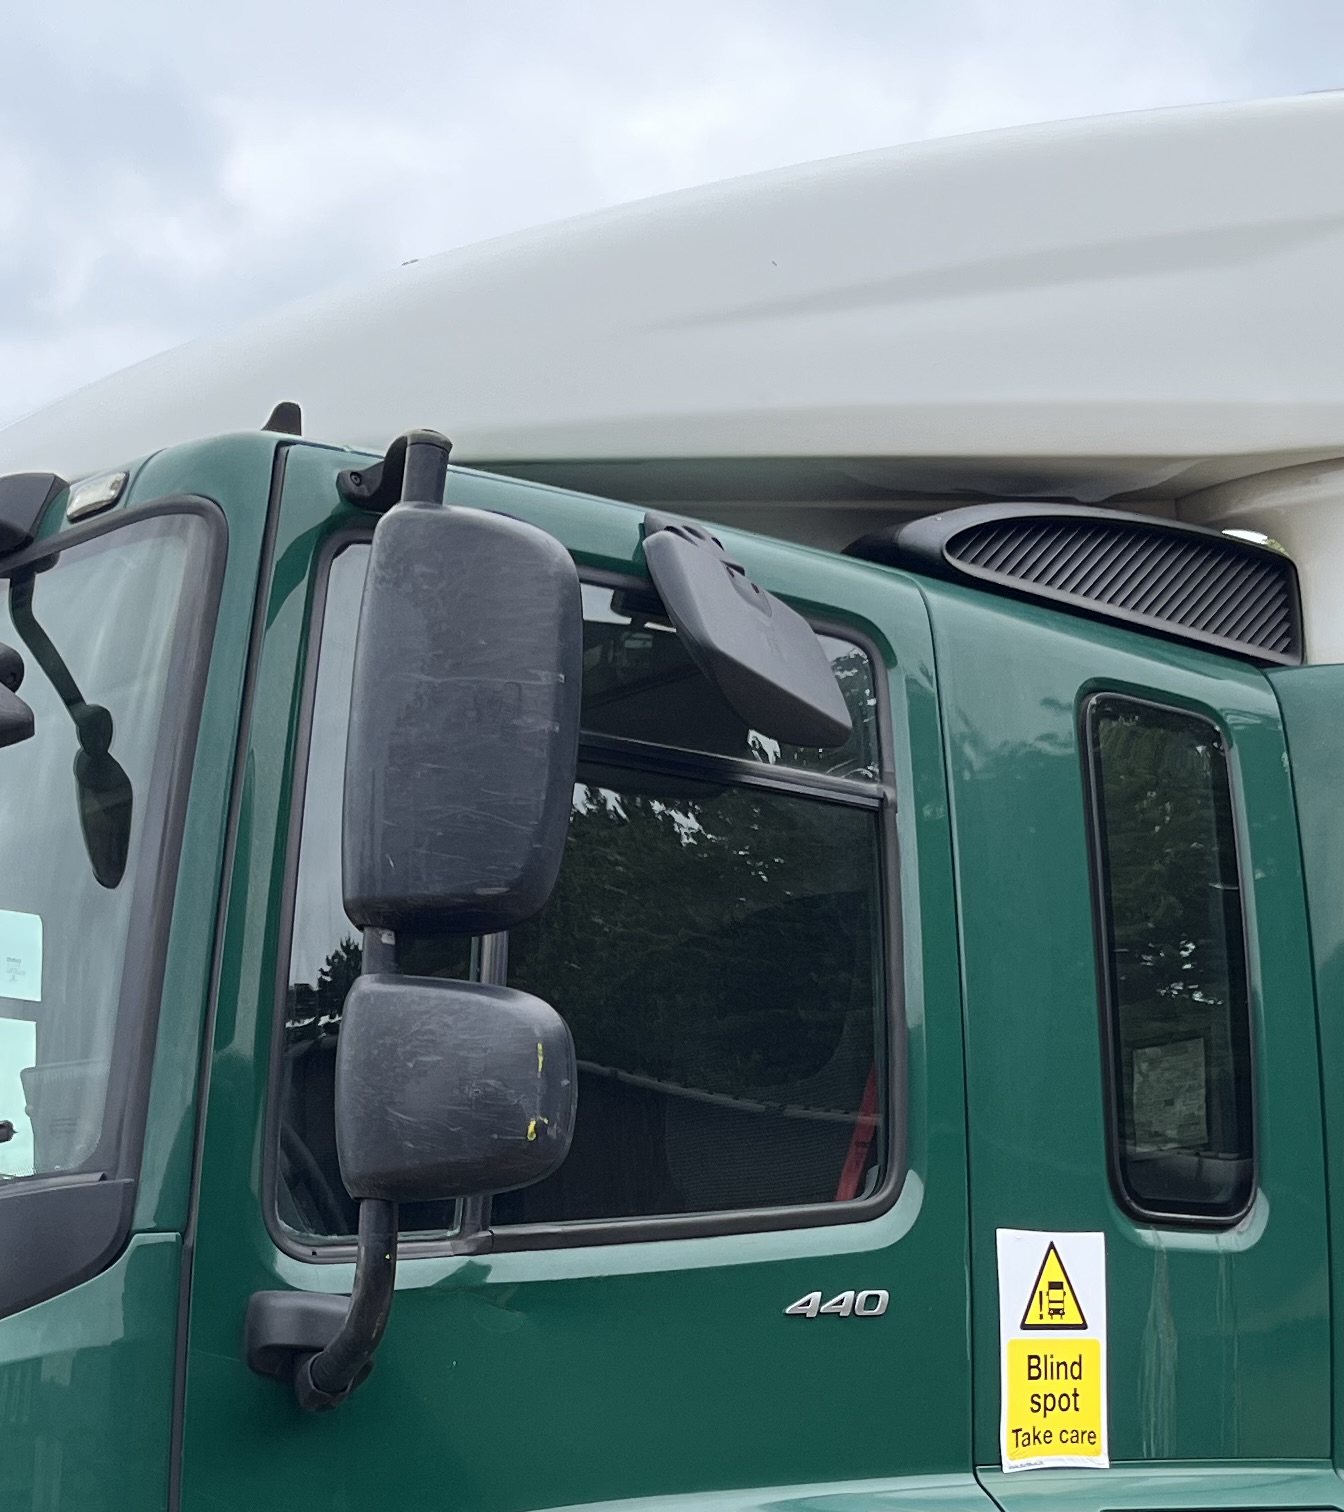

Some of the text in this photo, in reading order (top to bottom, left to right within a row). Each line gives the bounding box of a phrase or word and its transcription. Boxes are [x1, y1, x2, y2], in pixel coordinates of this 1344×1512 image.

[785, 1290, 889, 1318] 440
[1027, 1354, 1083, 1381] Blind
[1030, 1388, 1080, 1418] spot
[1012, 1427, 1097, 1448] Take care
